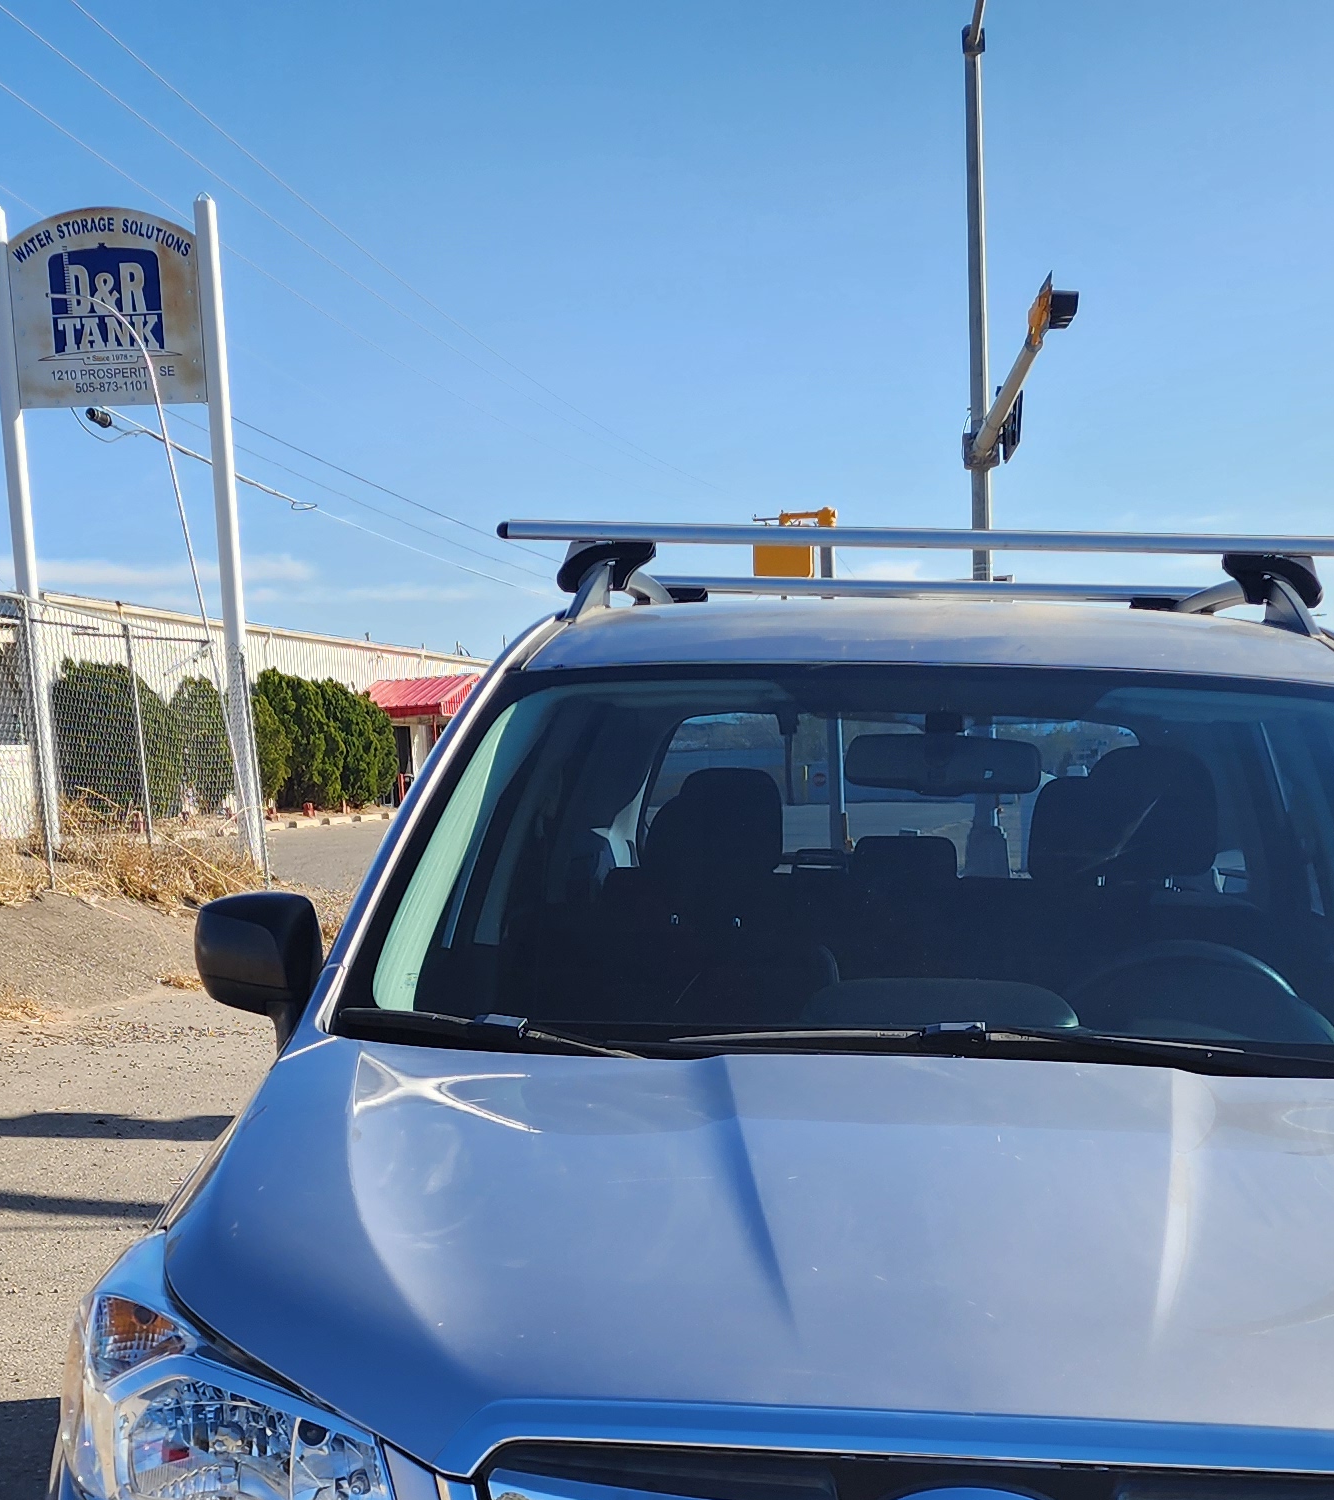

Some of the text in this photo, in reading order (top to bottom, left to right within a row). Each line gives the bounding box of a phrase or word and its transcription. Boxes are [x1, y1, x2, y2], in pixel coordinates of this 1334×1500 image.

[12, 216, 191, 264] WATER STORAGE SOLUTIONS
[68, 262, 147, 314] D&R
[58, 315, 161, 353] TANK
[51, 365, 176, 381] 1210 PROSPERIT SE
[75, 380, 148, 393] 505-873-1101
